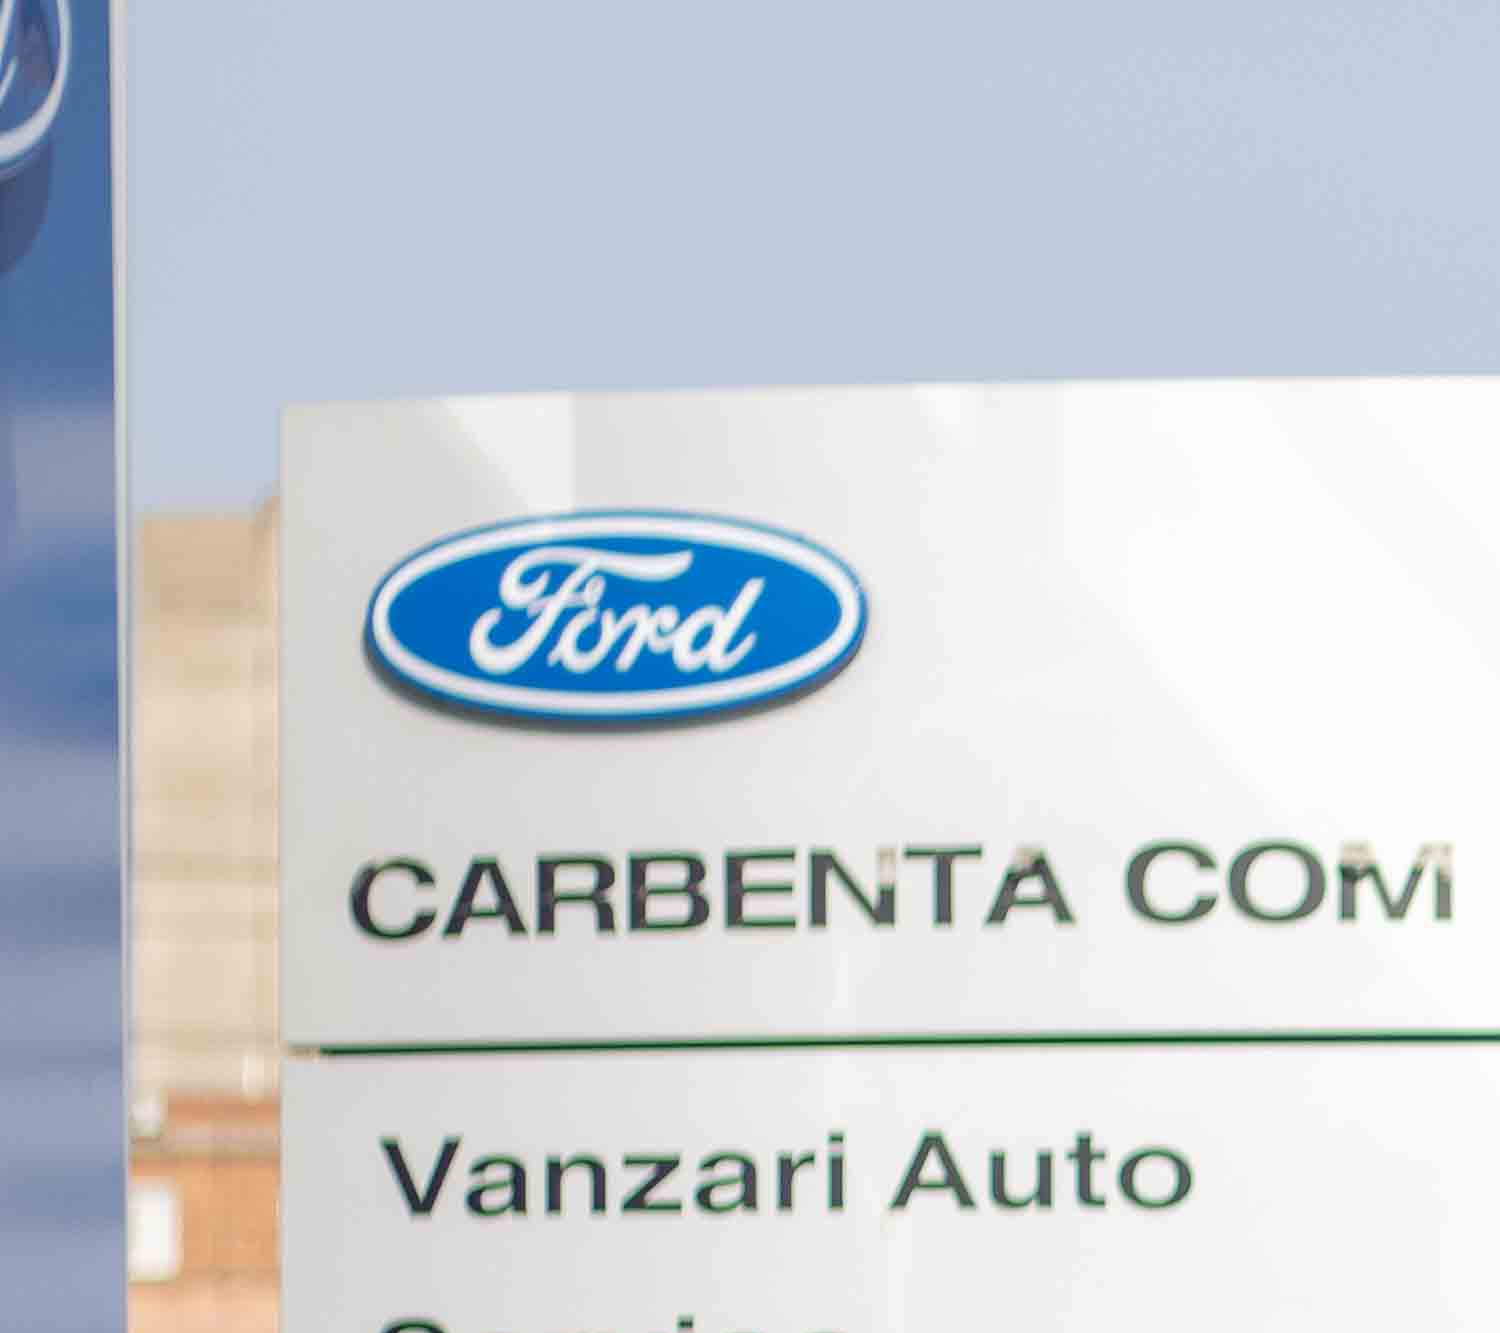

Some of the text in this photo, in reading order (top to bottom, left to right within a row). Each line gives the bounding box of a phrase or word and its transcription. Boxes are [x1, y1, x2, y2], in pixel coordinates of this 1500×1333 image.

[468, 547, 766, 676] Ford
[348, 838, 1455, 943] CARBENTA COM
[380, 1130, 1194, 1219] Vanzari Auto
